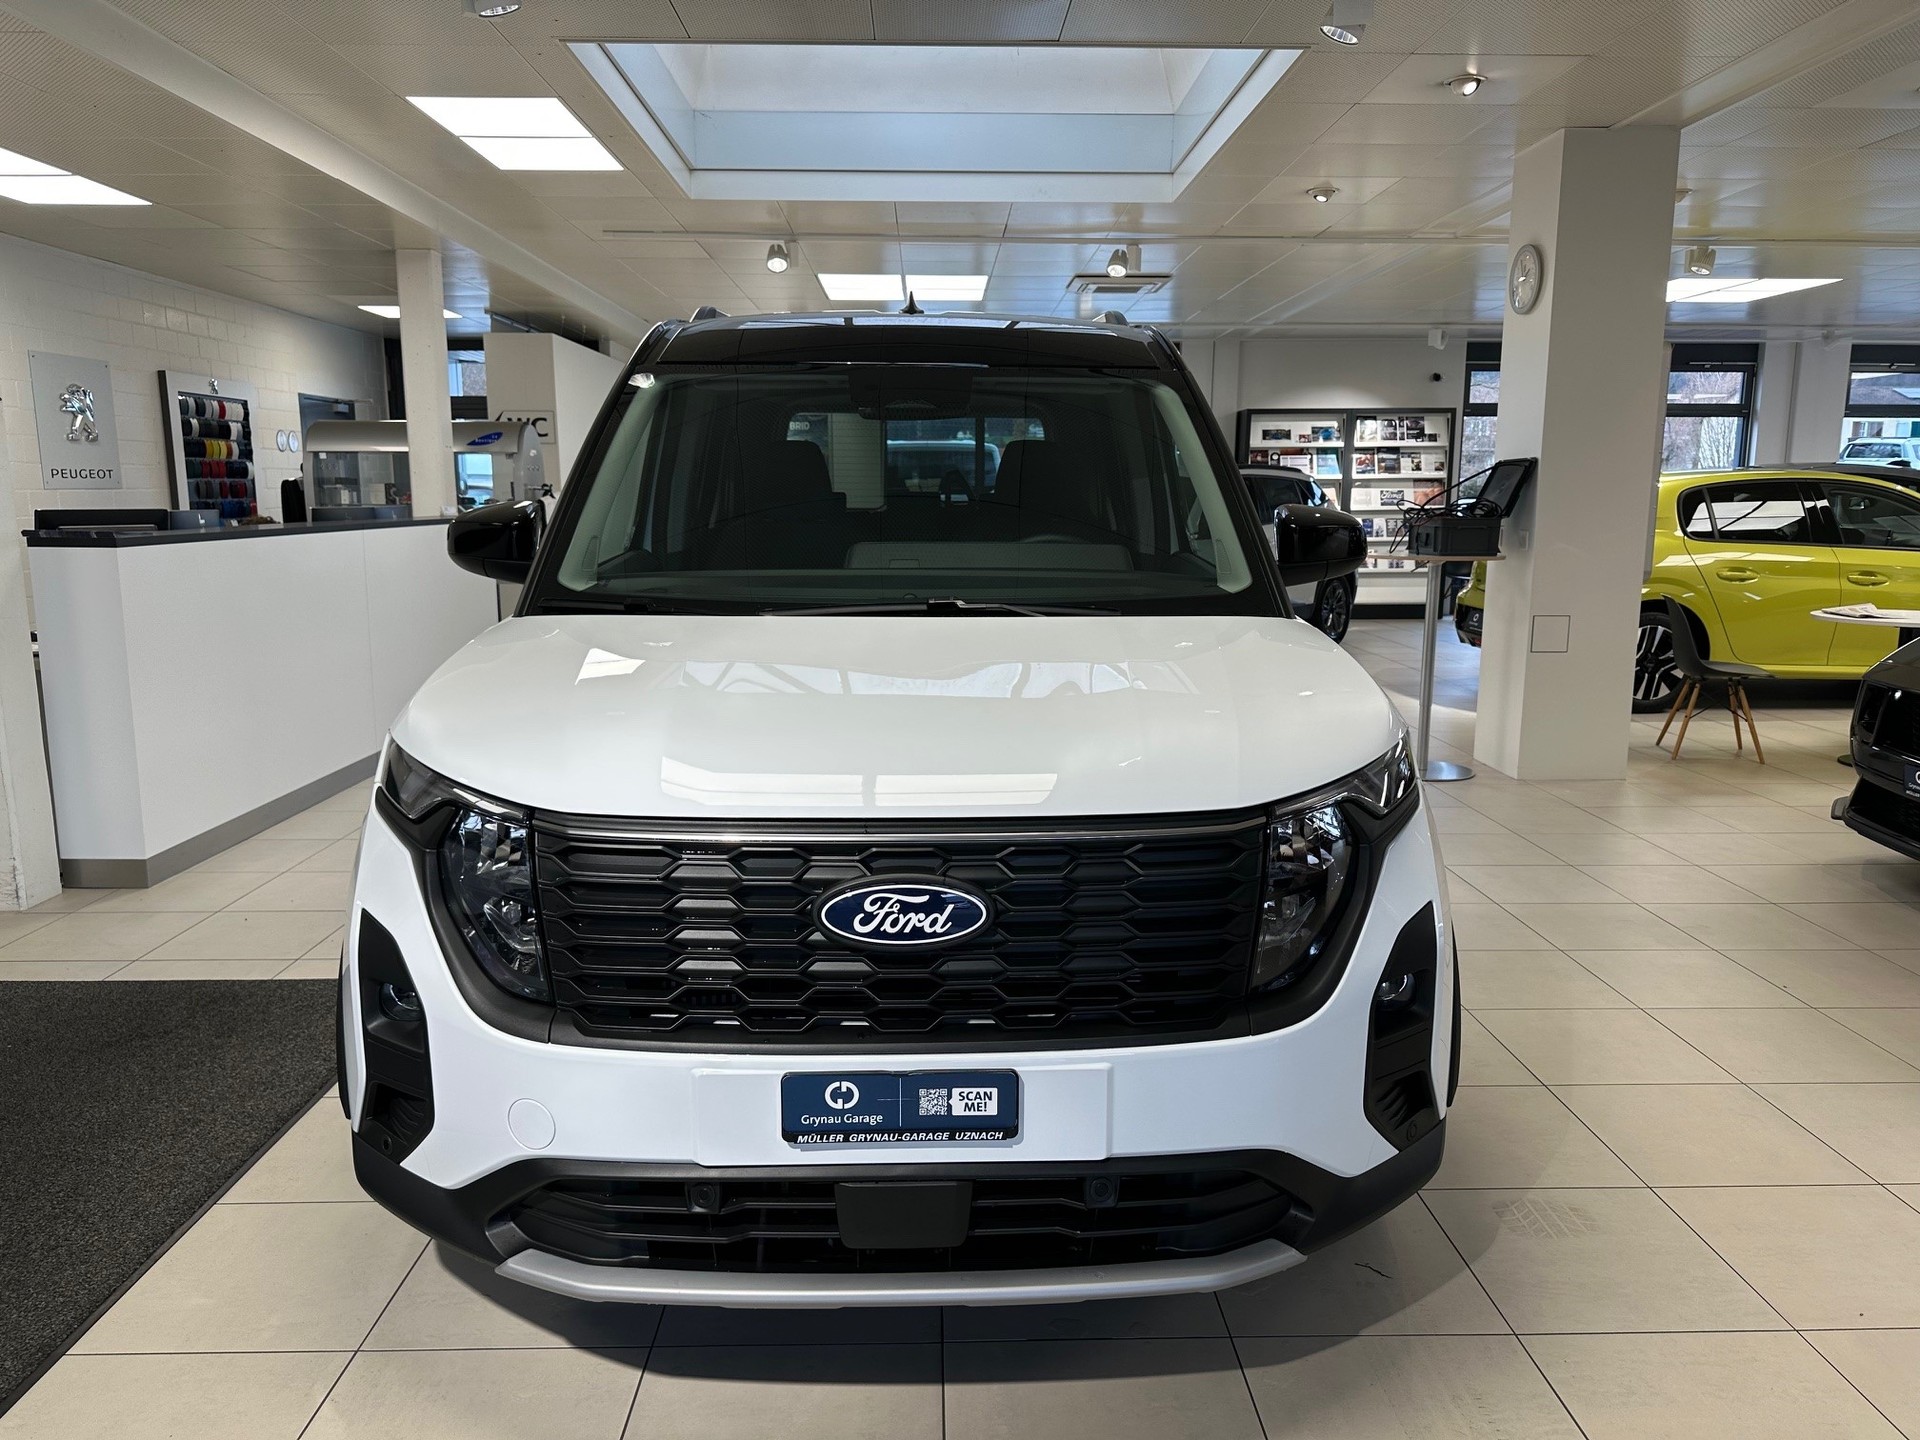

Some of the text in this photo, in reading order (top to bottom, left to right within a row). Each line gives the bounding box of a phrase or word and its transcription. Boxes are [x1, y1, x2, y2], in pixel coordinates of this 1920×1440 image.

[50, 468, 114, 480] PEUGEOT
[853, 892, 955, 934] Ford
[958, 1090, 993, 1101] SCAN
[963, 1101, 988, 1112] ME!
[801, 1113, 883, 1127] Grynau Garage
[797, 1131, 1004, 1143] MÜLLER GRYNAU-GARAGE UZNACH
